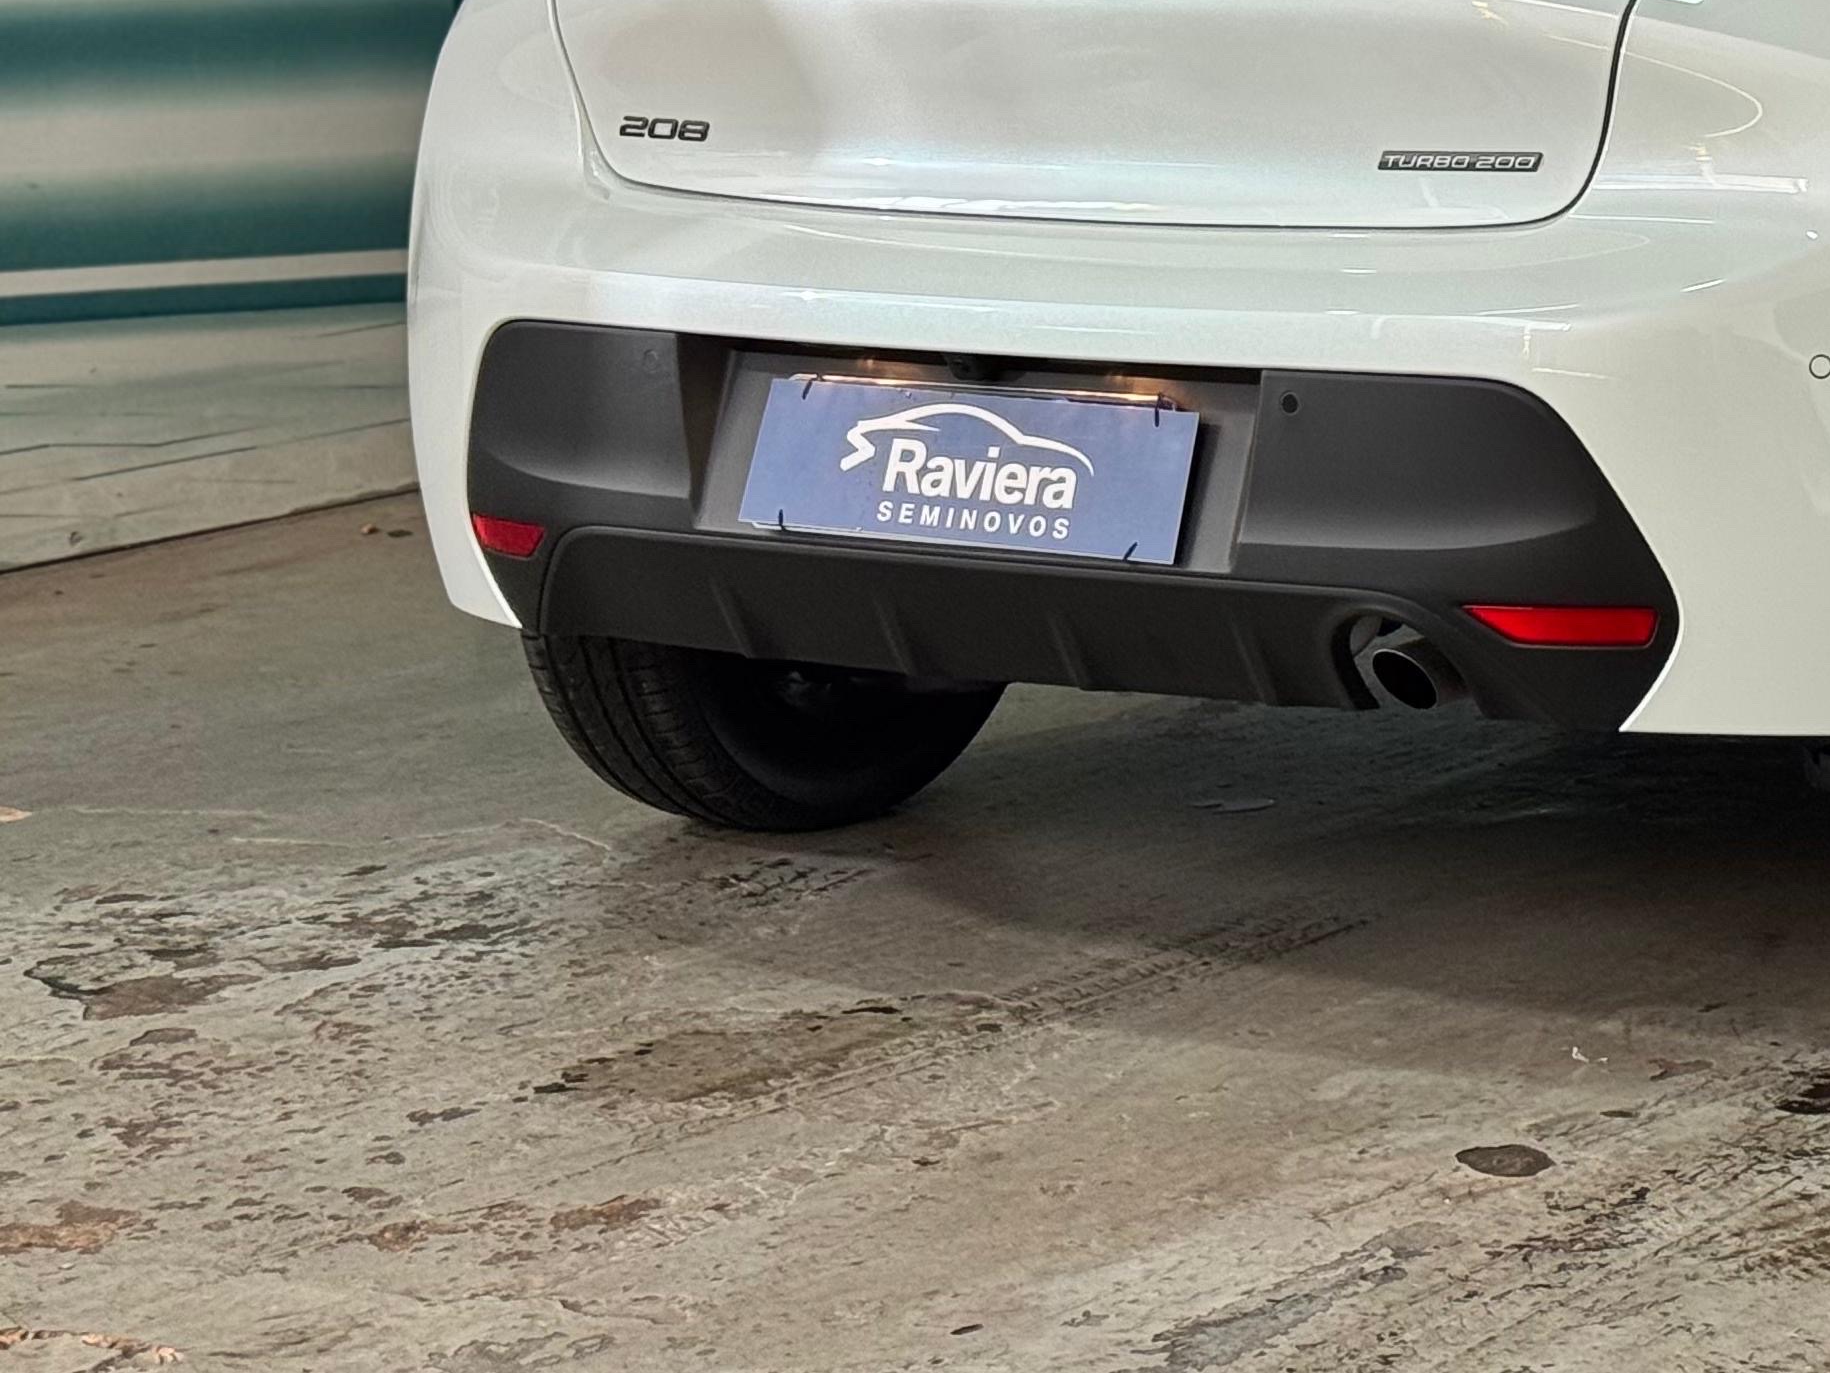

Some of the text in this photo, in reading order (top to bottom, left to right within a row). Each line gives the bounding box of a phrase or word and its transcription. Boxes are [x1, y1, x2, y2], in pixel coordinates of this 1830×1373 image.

[619, 115, 711, 142] 208
[1383, 154, 1538, 170] TURBO 200
[881, 437, 1079, 511] Raviera
[876, 500, 1071, 541] SEMINOVOS
